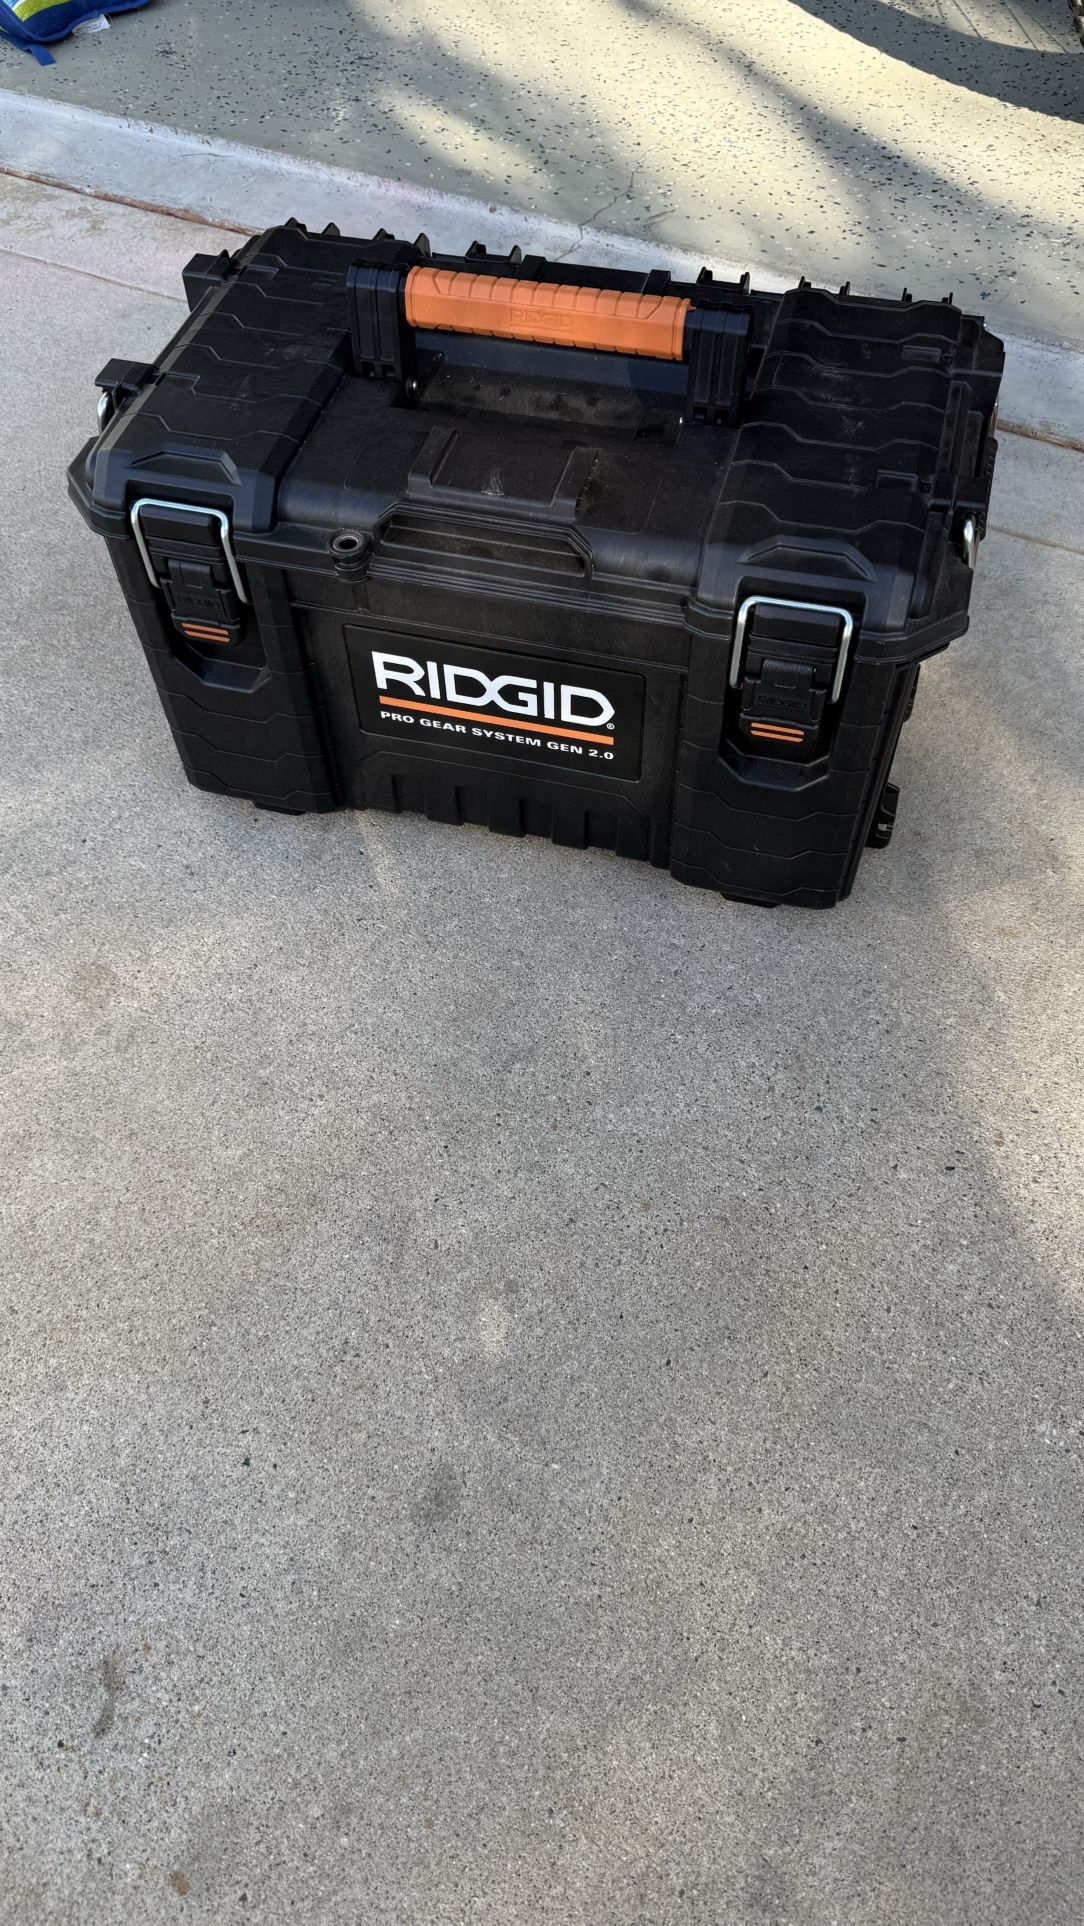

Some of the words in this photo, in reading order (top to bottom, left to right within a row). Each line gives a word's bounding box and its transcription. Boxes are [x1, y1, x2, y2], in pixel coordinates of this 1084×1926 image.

[511, 309, 574, 328] RIDGID
[372, 651, 615, 727] RIDGID
[380, 710, 414, 724] PRO
[419, 717, 467, 734] GEAR
[471, 727, 541, 747] SYSTEM
[546, 741, 583, 755] GEN
[588, 748, 614, 760] 2.0
